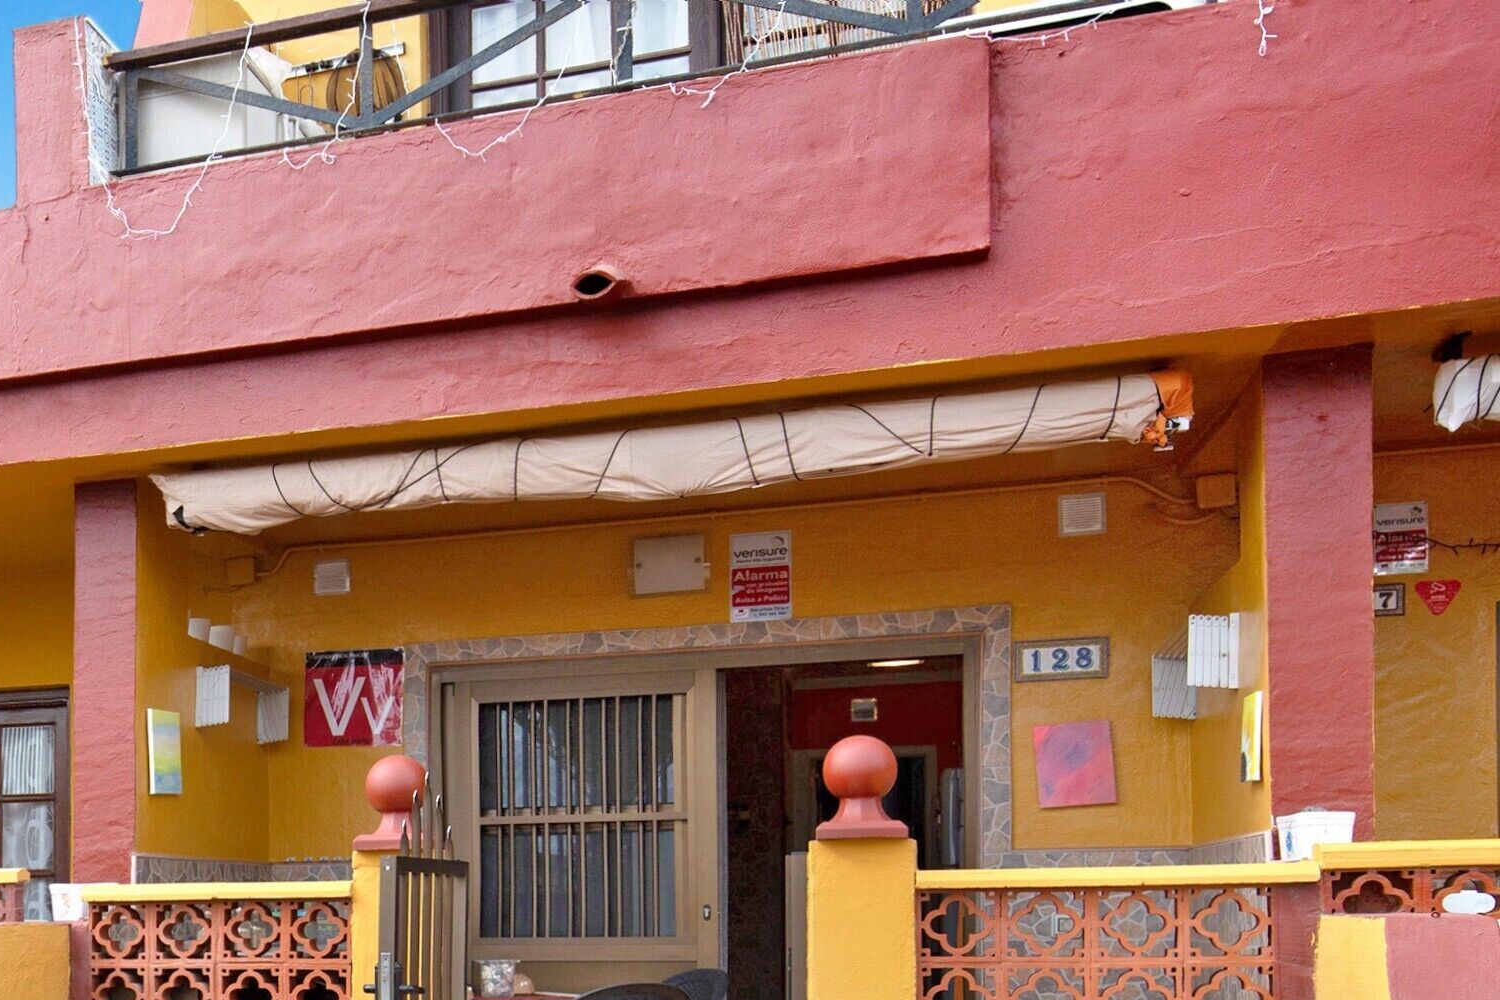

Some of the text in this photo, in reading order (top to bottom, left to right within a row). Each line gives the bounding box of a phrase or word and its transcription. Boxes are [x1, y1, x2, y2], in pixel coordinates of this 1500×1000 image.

[1377, 516, 1425, 526] verisure
[733, 547, 788, 558] verisure
[734, 569, 788, 581] Alarma
[1030, 647, 1094, 672] 128
